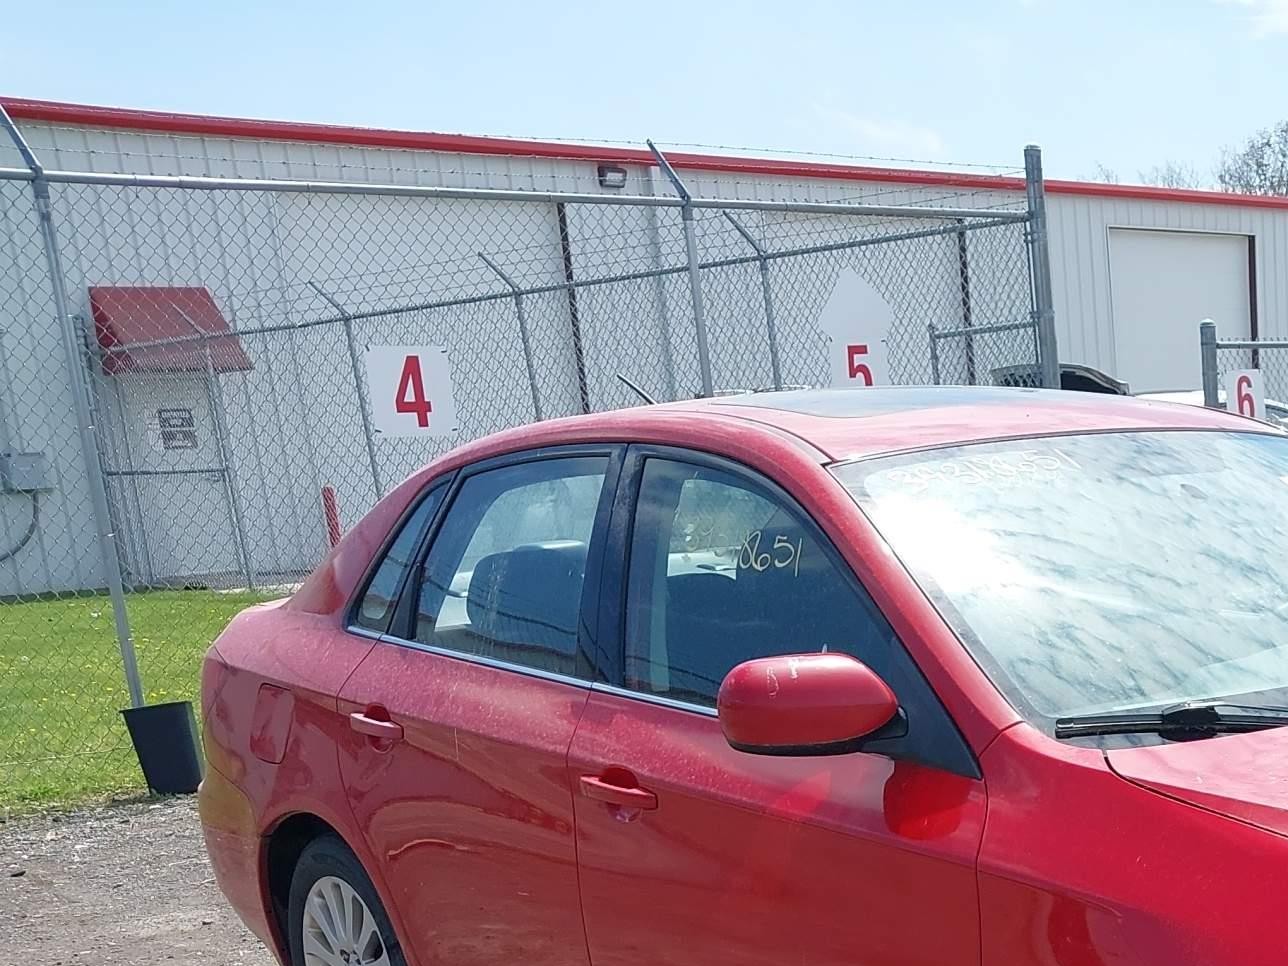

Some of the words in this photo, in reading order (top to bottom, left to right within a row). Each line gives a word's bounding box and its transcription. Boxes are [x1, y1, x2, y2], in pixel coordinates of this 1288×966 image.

[847, 345, 873, 387] 5
[396, 355, 432, 427] 4
[1237, 375, 1255, 417] 6
